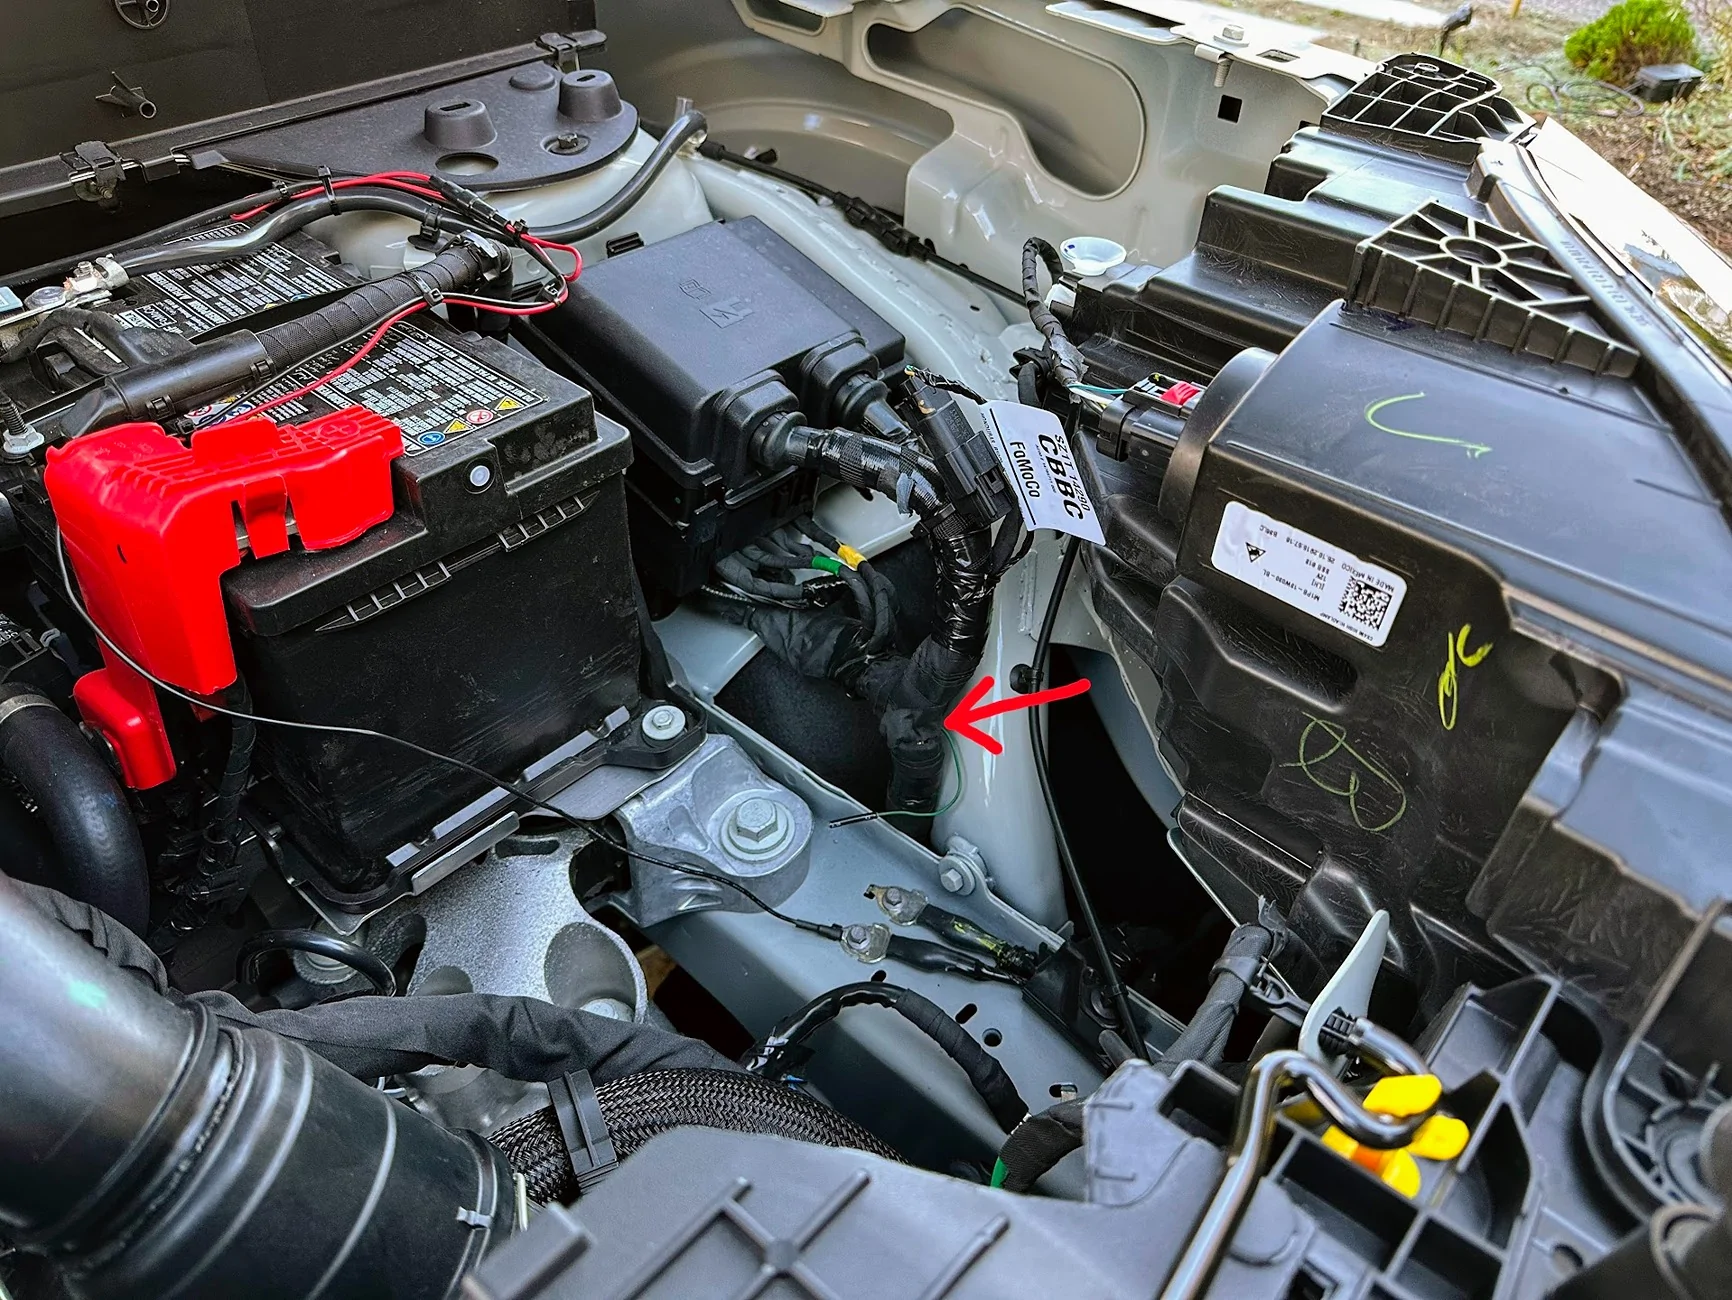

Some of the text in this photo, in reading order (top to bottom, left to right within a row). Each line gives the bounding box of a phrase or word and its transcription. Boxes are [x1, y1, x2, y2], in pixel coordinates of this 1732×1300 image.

[1009, 441, 1042, 498] FoMoCo
[1036, 433, 1085, 520] CBBC
[1053, 434, 1090, 511] SZ1T 14290
[1339, 561, 1366, 579] MEXICO
[1364, 573, 1375, 583] IN
[1374, 577, 1395, 593] MADE
